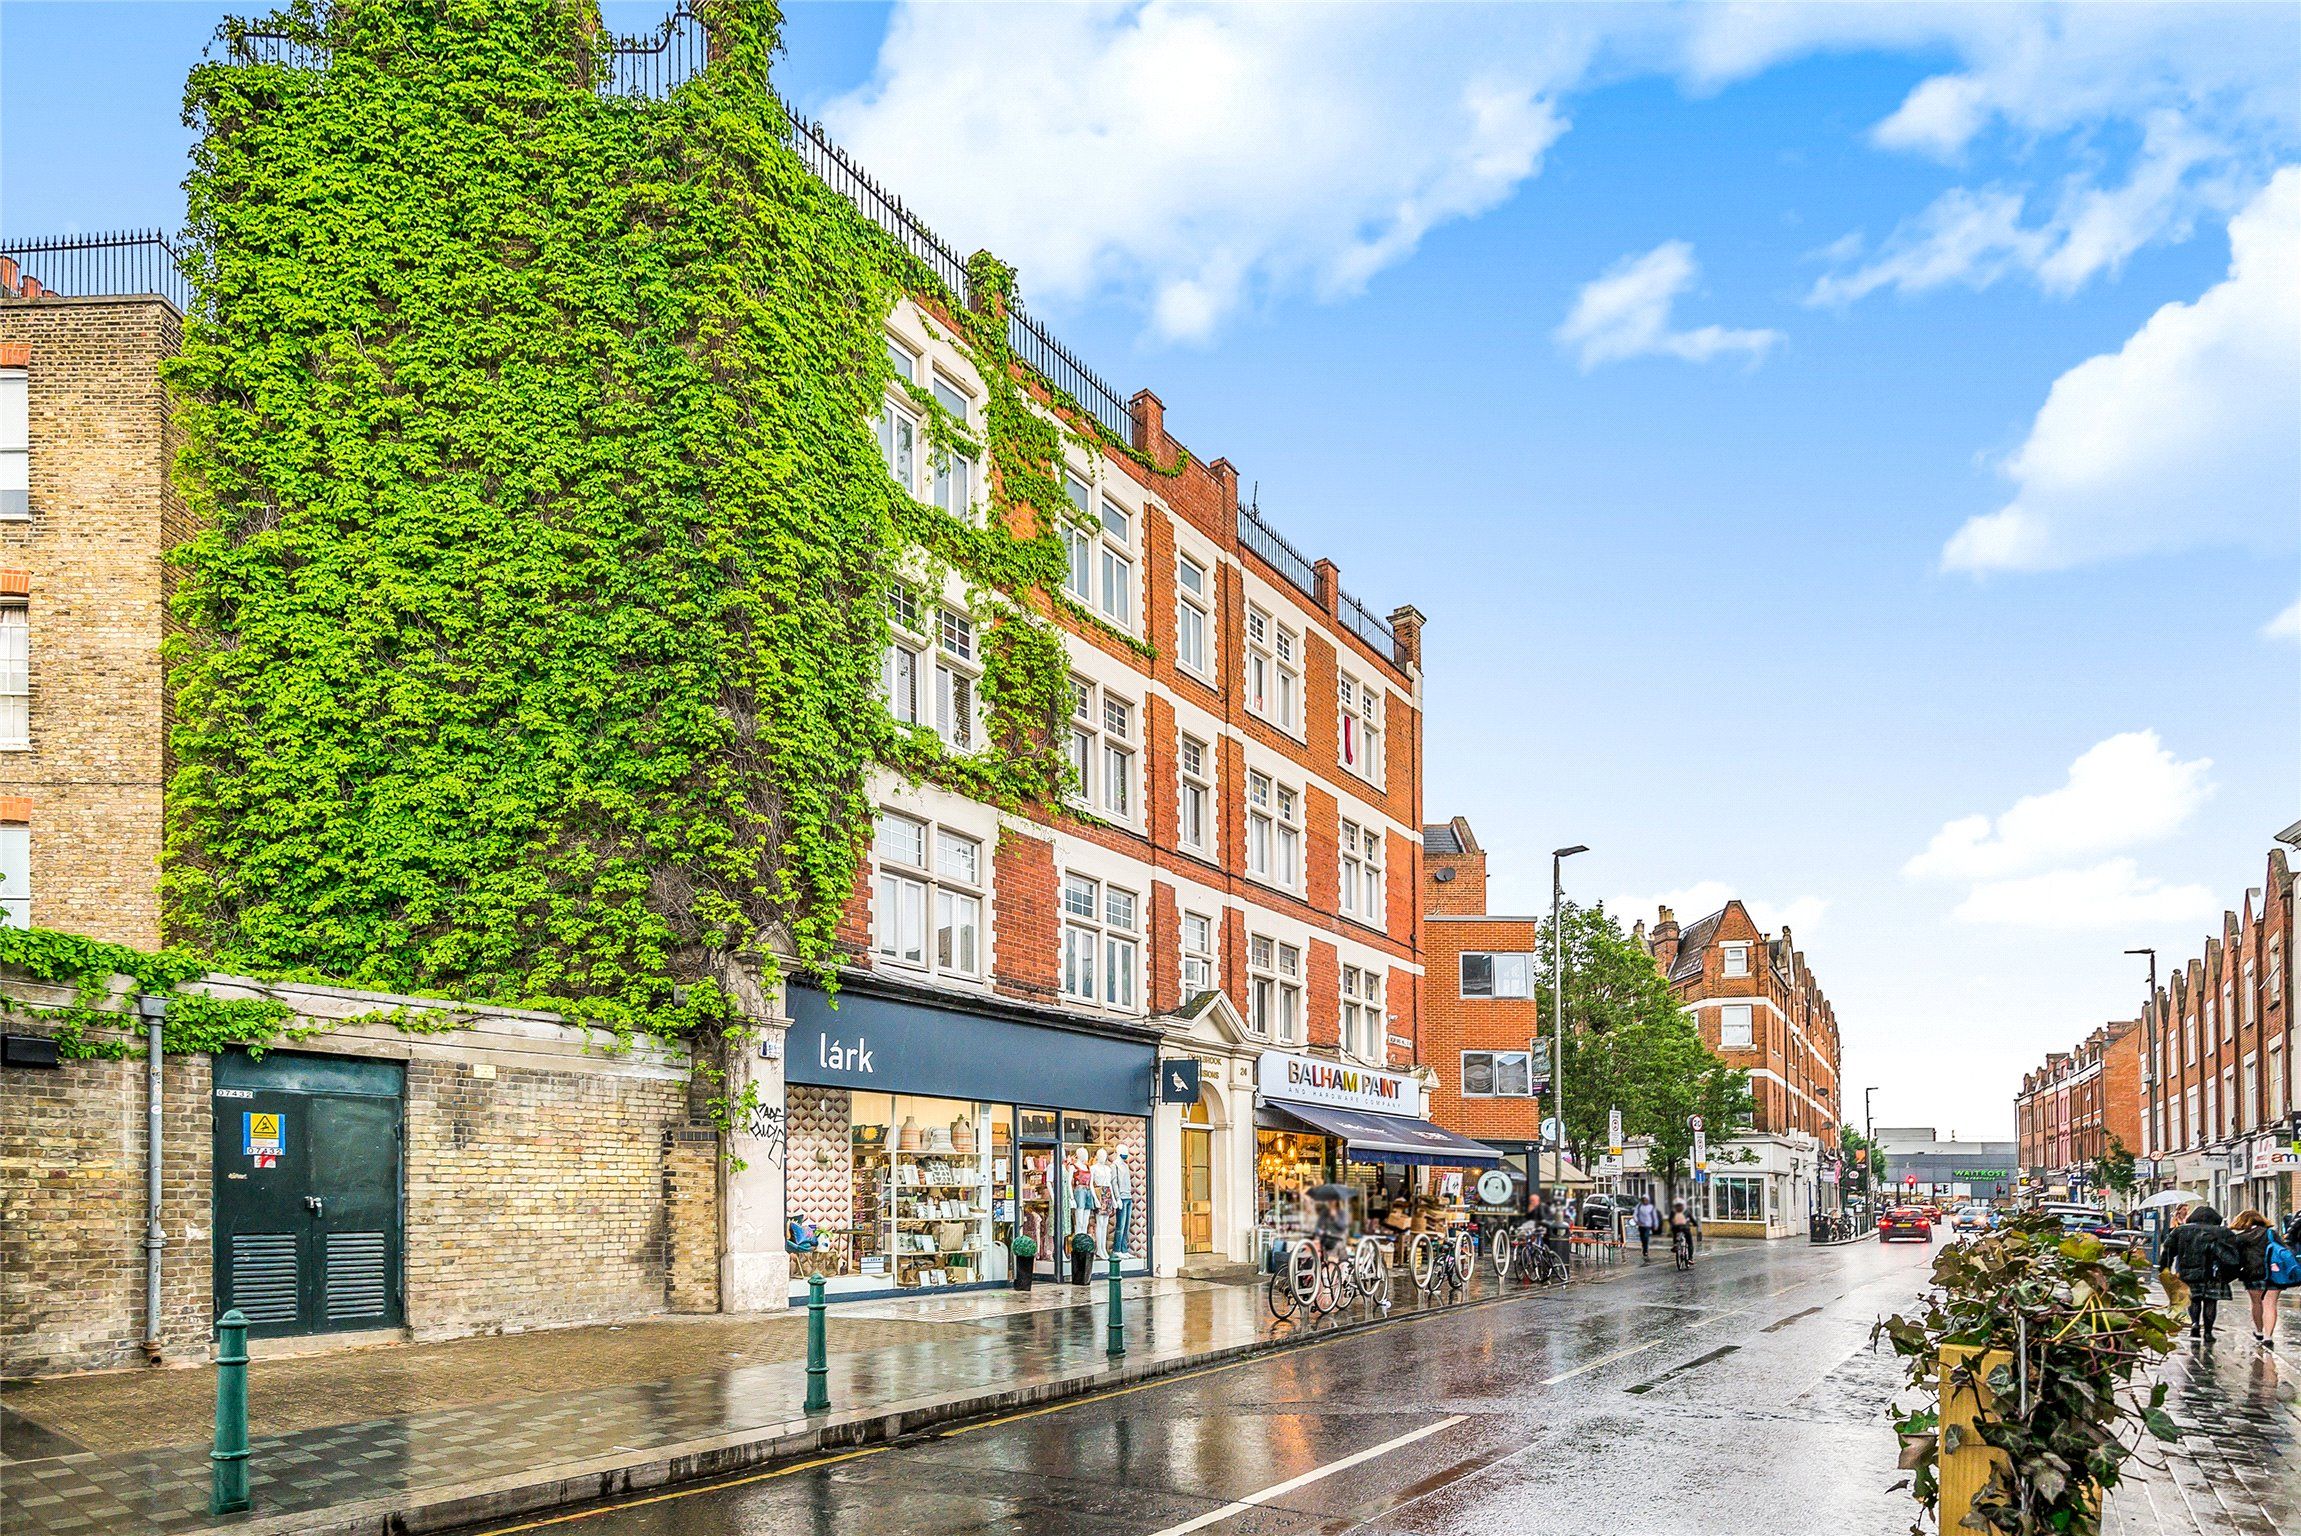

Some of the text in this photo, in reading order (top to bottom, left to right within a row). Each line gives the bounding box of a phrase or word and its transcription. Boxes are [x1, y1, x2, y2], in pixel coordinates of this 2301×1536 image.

[1240, 1067, 1248, 1076] 24
[1288, 1060, 1402, 1100] BALHAM PAINT
[217, 1089, 252, 1098] 07432
[1288, 1087, 1401, 1108] AND HARDWARE COMPANY
[248, 1147, 282, 1155] 07432
[1954, 1168, 2007, 1177] WAITROSE
